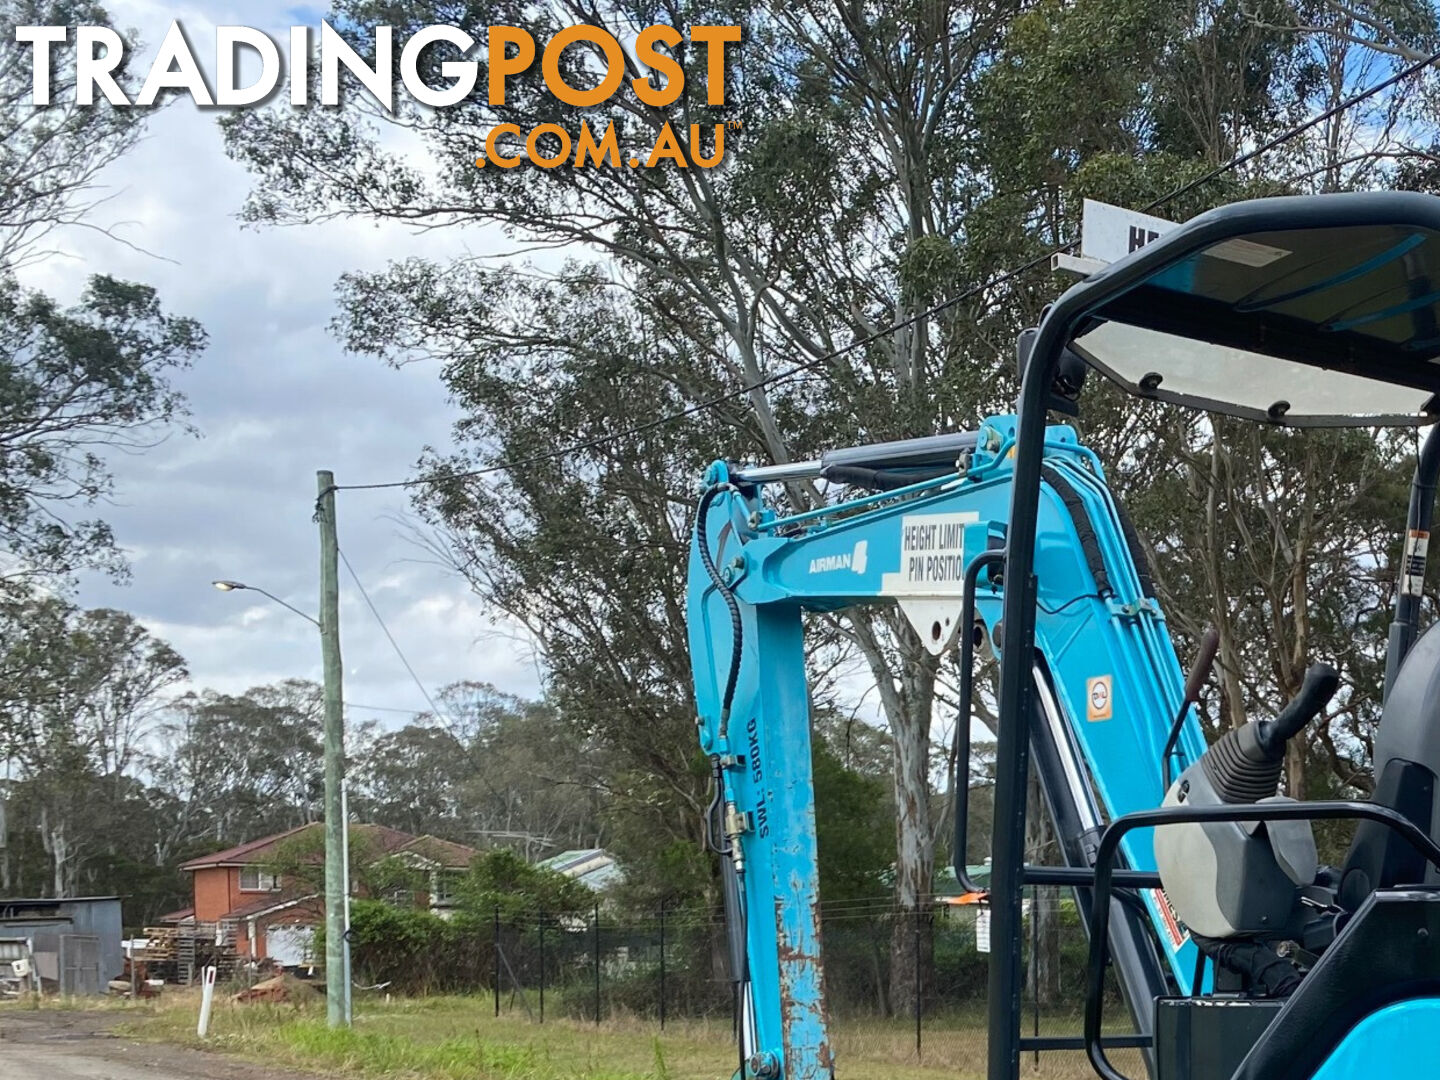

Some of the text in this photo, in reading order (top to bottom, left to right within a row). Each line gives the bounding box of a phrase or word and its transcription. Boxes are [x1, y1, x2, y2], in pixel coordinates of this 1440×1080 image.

[904, 523, 964, 551] HEIGHT LIMIT
[809, 553, 851, 574] AIRMAN
[909, 554, 965, 581] PIN POSITIO
